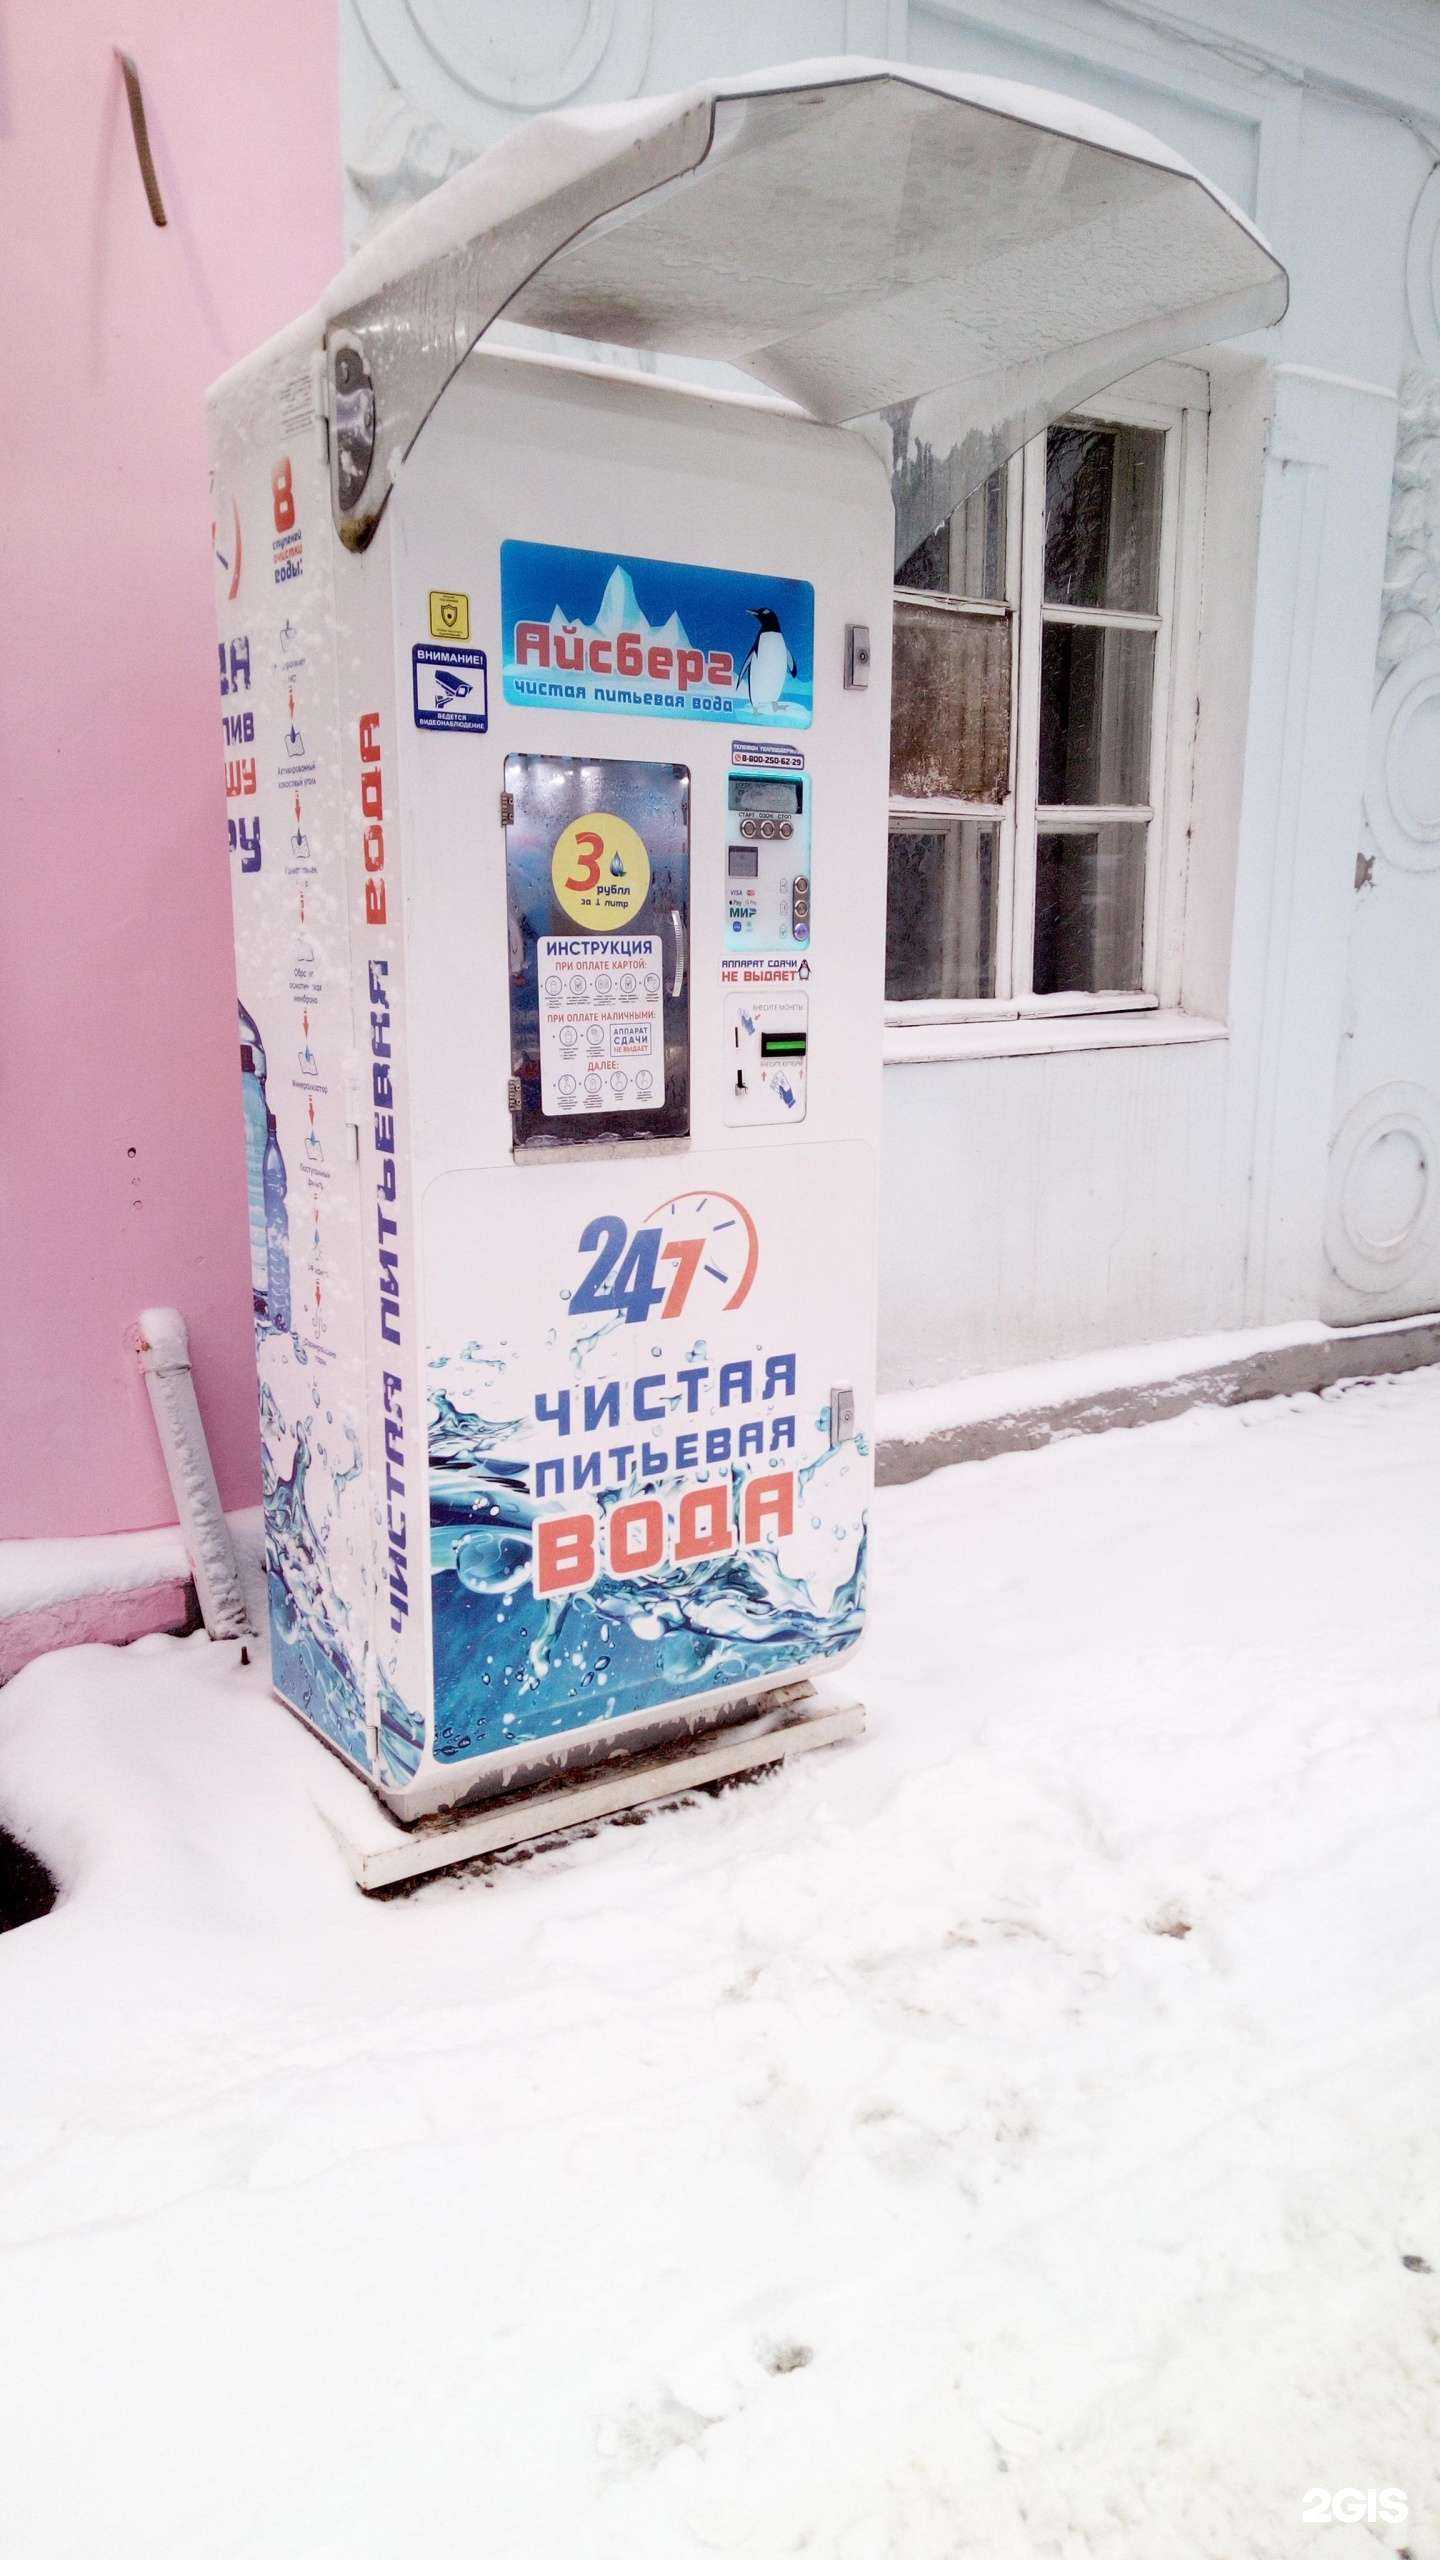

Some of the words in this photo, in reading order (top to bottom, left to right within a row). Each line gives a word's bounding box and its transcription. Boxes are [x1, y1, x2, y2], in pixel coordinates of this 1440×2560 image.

[272, 456, 295, 533] 8
[417, 650, 483, 665] ВНИМАНИЕ!
[517, 623, 733, 690] Айсберг
[515, 680, 586, 699] чистая
[594, 687, 685, 708] питьевая
[693, 695, 733, 713] вода
[420, 718, 484, 730] ВИДЕОНАБЛЮДЕНИЕ
[741, 754, 802, 766] 8-800-250-62-29
[360, 712, 387, 924] ВОДА
[565, 832, 604, 891] 3
[580, 898, 592, 906] за
[604, 900, 629, 909] литр
[729, 907, 757, 918] МИР
[546, 940, 653, 957] ИНСТРУКЦИЯ
[555, 961, 574, 971] ПРИ
[576, 960, 609, 971] ОПЛАТЕ
[612, 958, 648, 970] КАРТОЙ:
[721, 959, 765, 968] АППАРАТ
[767, 959, 797, 968] СДАЧИ
[721, 970, 739, 982] НЕ
[743, 970, 797, 982] ВЫДАЕТ
[547, 1014, 564, 1023] ПРИ
[567, 1013, 599, 1023] ОПЛАТЕ
[601, 1012, 656, 1022] НАЛИЧНЫМИ:
[613, 1026, 648, 1036] АППАРАТ
[613, 1036, 648, 1046] СДАЧИ
[587, 1061, 620, 1072] ДАЛЕЕ:
[368, 960, 400, 1346] ПИТЬЕВАЯ
[534, 1353, 797, 1436] ЧИСТАЯ
[535, 1415, 797, 1498] ПИТЬЕВАЯ
[383, 1371, 409, 1634] ЧИСТАЯ
[538, 1471, 794, 1593] ВОДА
